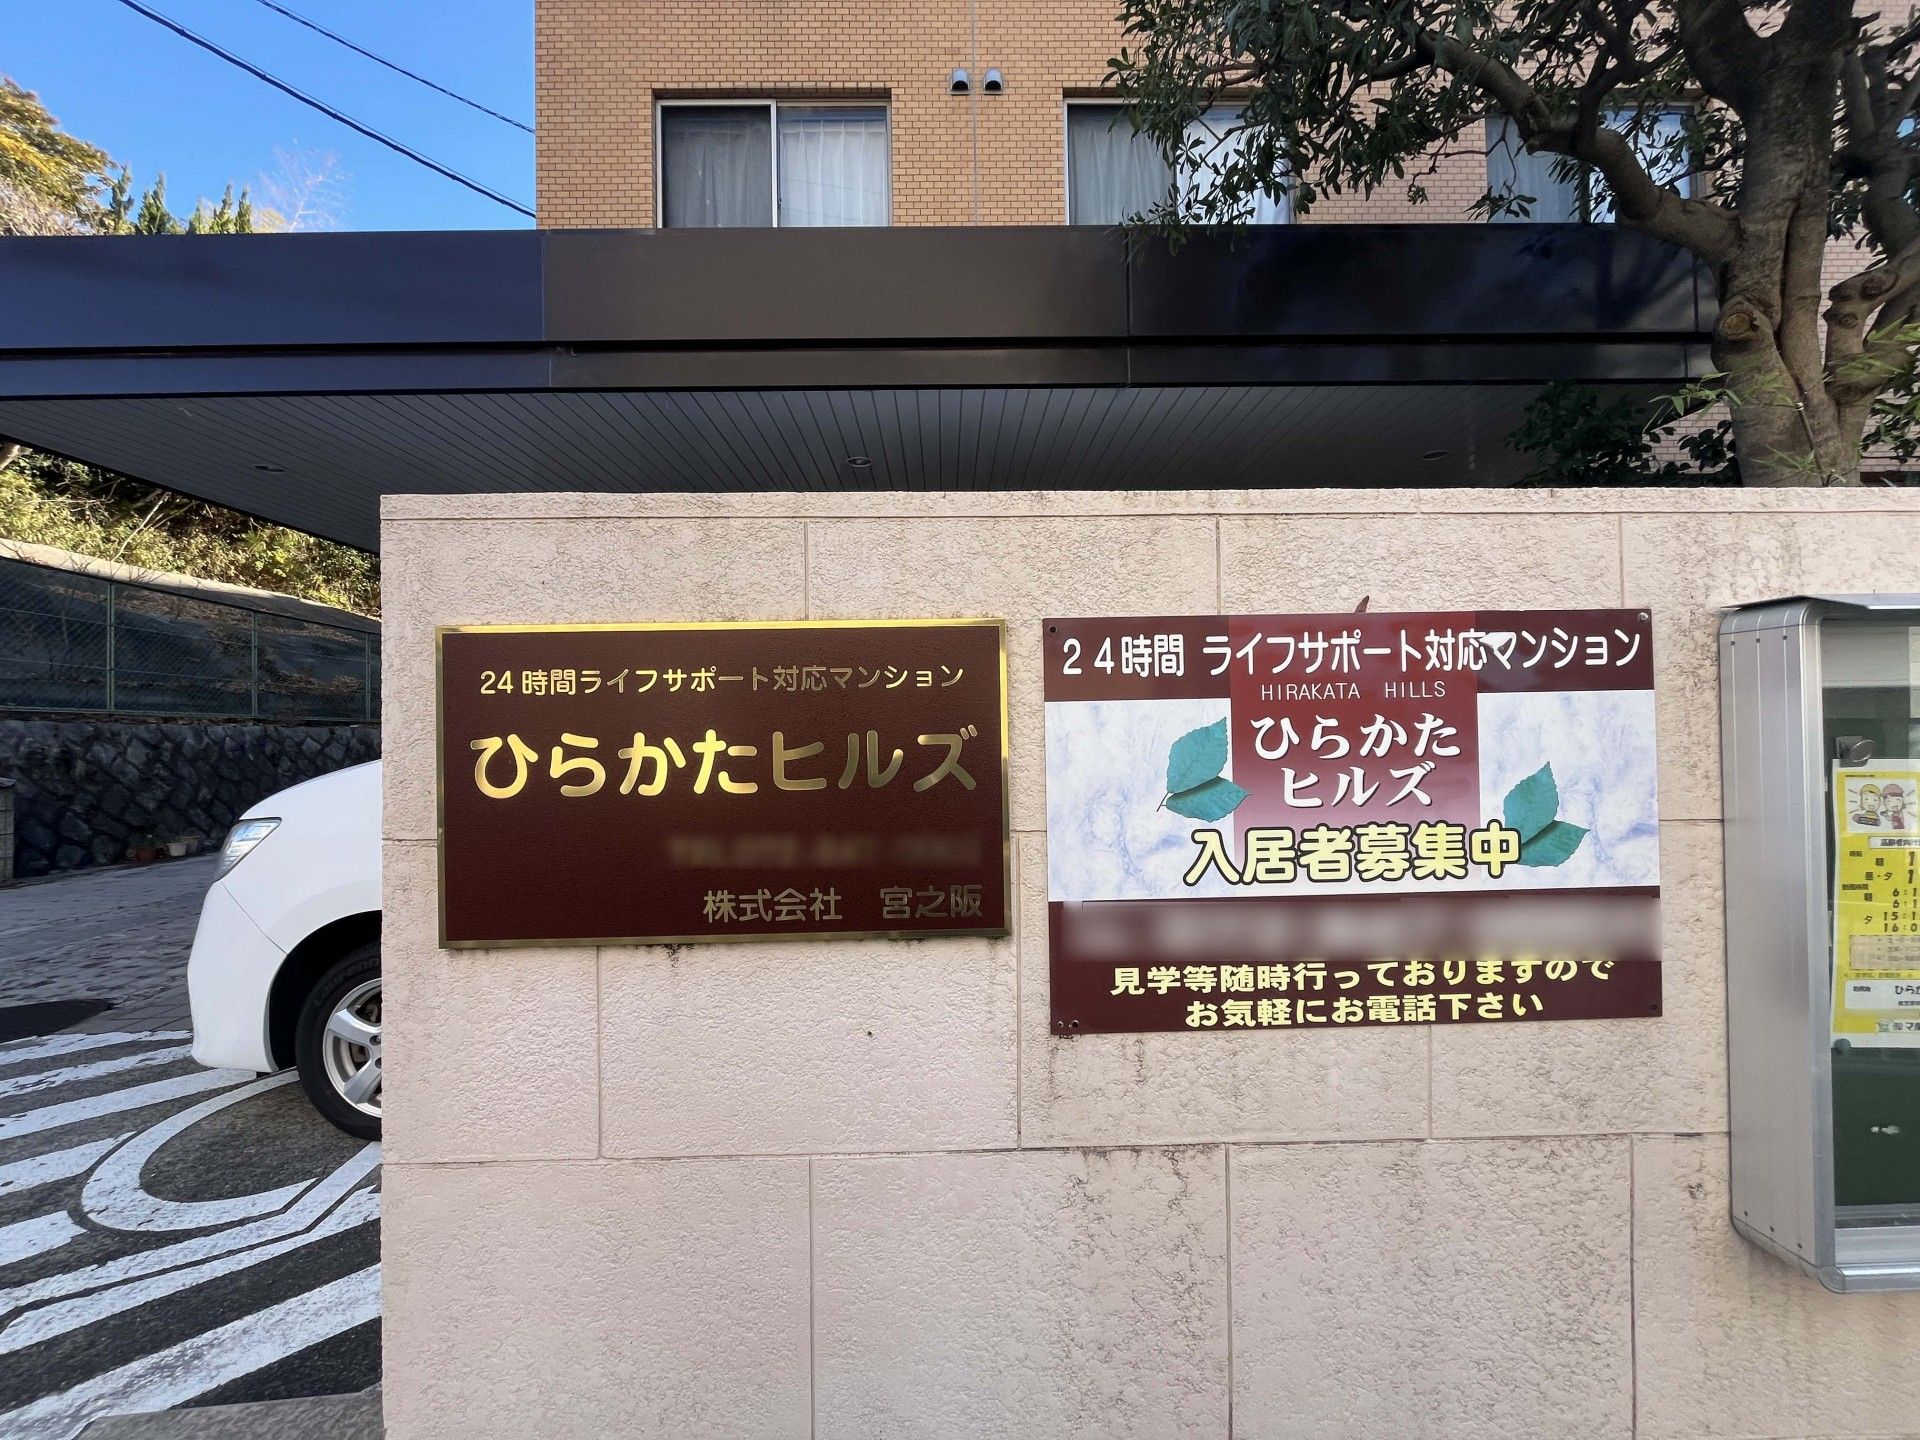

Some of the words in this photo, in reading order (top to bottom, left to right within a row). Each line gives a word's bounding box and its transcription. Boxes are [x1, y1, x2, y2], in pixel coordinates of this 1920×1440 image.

[1062, 633, 1185, 678] 24時間
[1203, 627, 1640, 676] ライフサポート対応マンション
[480, 665, 964, 696] 24時間ライフサポート対応マンション
[1262, 682, 1361, 701] HIRAKATA
[1385, 680, 1446, 699] HILLS
[1250, 712, 1461, 760] ひらかた
[470, 724, 978, 799] ひらかたヒルズ
[1280, 760, 1436, 808] ヒルズ
[1182, 819, 1522, 887] 入居者募集中
[703, 886, 843, 923] 株式会社
[880, 884, 984, 919] 宮之阪
[1110, 957, 1615, 996] 見学等随時行っておりますので
[1185, 991, 1544, 1028] お気軽にお電話下さい
